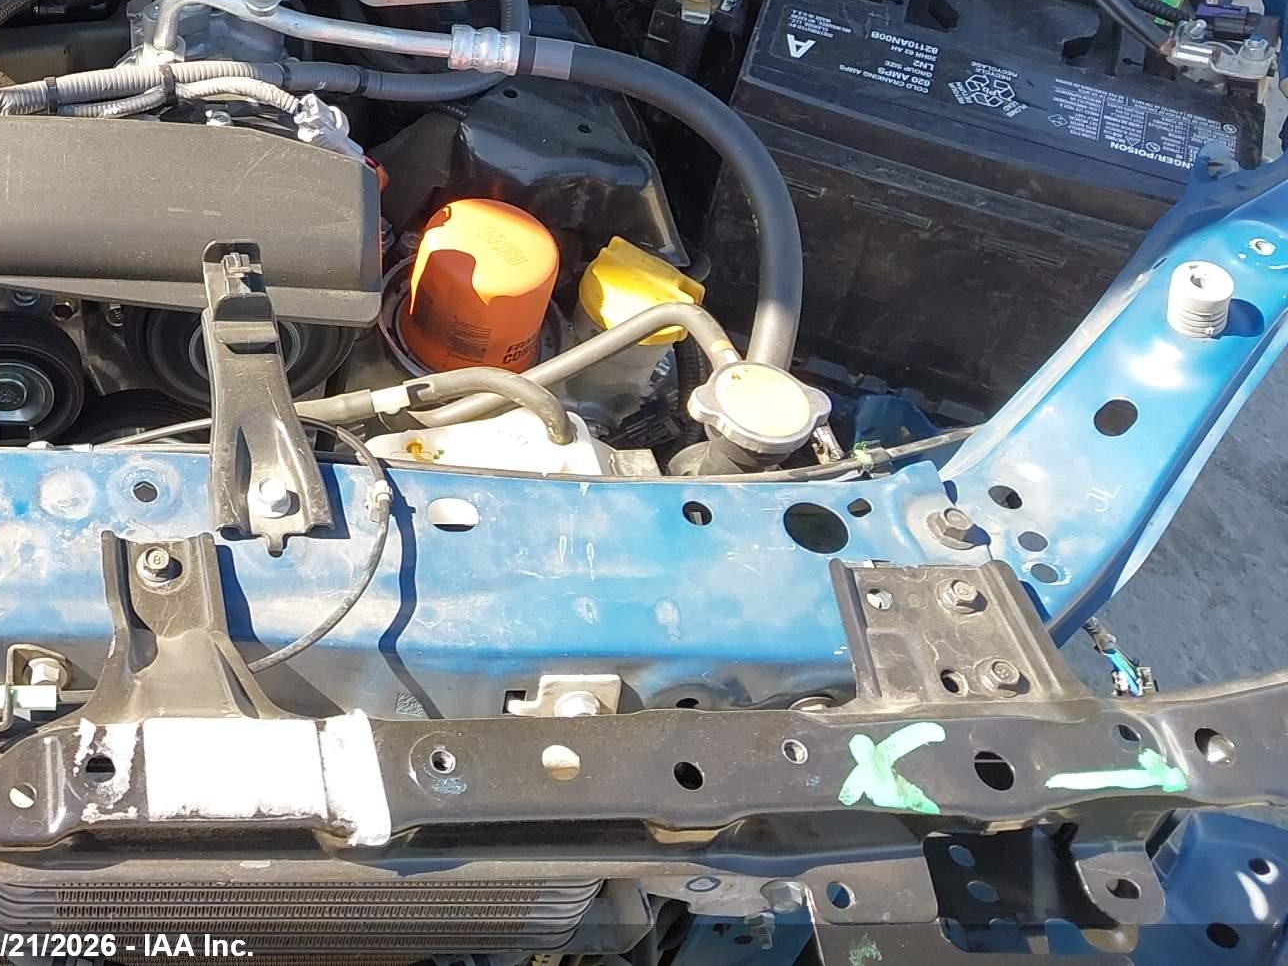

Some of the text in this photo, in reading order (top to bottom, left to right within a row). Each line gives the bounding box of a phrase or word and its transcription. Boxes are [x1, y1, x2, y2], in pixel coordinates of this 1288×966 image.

[786, 34, 816, 58] A
[871, 31, 938, 55] 82110AN00B
[890, 45, 904, 53] AH
[884, 60, 933, 78] GROUP SIZE
[912, 60, 934, 71] LN2
[970, 60, 1018, 78] RECYCLAGE
[976, 68, 1012, 80] RECYCLE
[840, 64, 928, 94] COLD CRANKING AMPS
[878, 66, 930, 87] 620 AMPS
[982, 87, 996, 96] Pb
[1110, 142, 1193, 170] NGER/POISON
